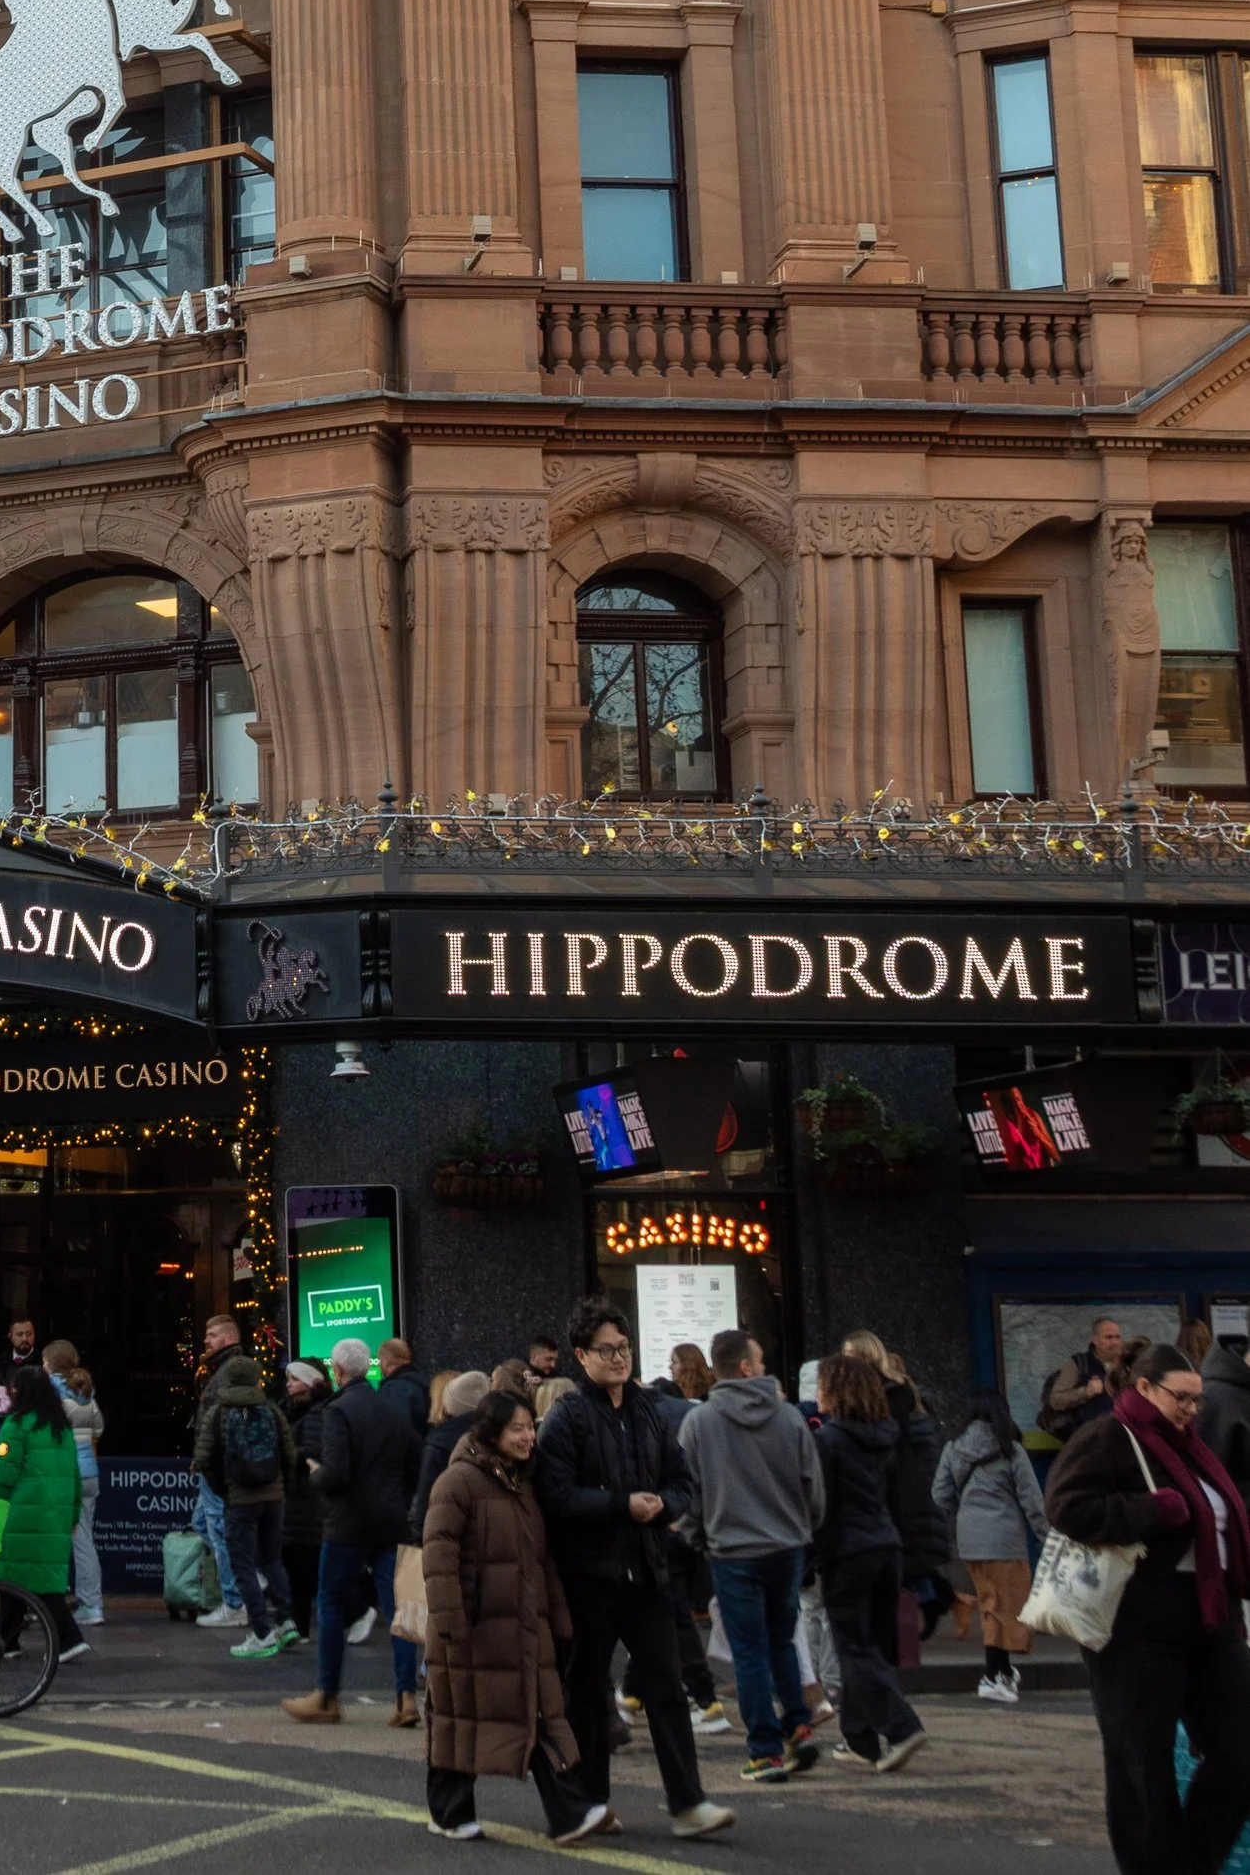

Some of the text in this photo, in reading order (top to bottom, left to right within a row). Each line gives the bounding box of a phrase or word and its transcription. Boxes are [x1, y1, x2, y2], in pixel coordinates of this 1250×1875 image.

[444, 931, 1091, 1001] HIPPODROME
[1179, 953, 1250, 990] LEI
[115, 1059, 228, 1088] CASINO
[1042, 1097, 1078, 1115] MAGIC
[1048, 1112, 1083, 1132] MIKE
[1054, 1128, 1090, 1151] LIVE
[607, 1212, 770, 1254] CASINO
[318, 1296, 373, 1315] PADDY'S
[326, 1316, 369, 1327] SPORTSBOOK
[110, 1471, 200, 1489] HIPPODRO
